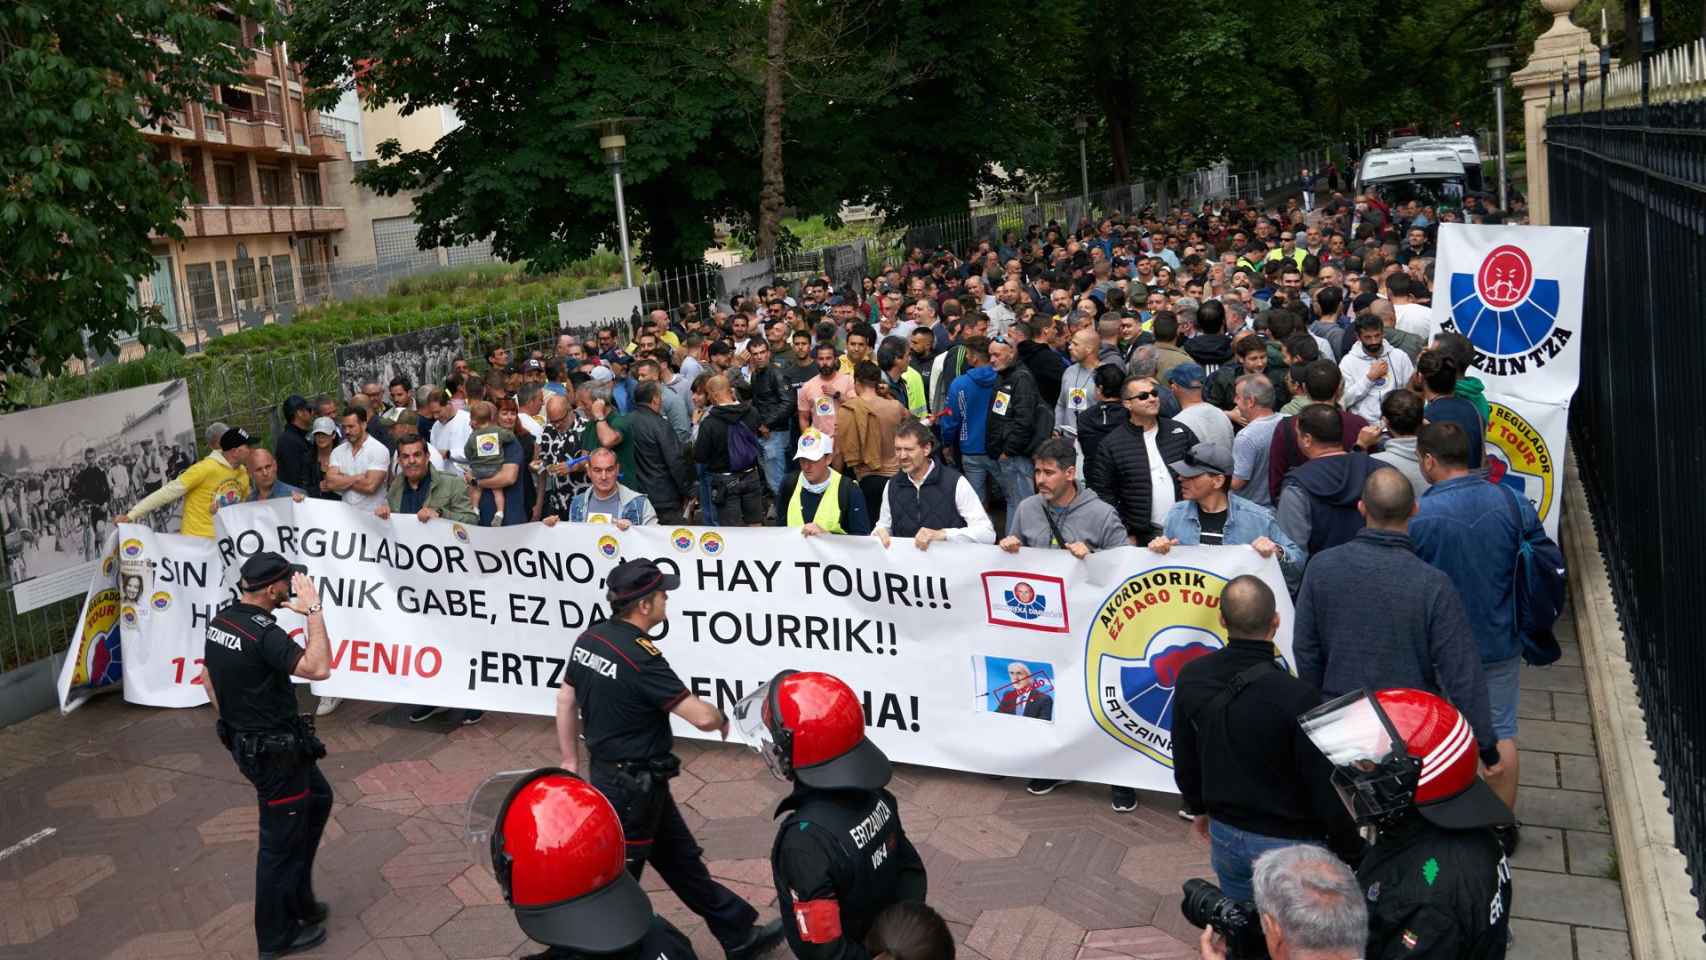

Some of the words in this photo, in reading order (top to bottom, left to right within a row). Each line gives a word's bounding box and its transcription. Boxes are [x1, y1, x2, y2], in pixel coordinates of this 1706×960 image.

[1440, 317, 1573, 376] EZAINTZA
[1496, 407, 1551, 474] REGULADOR
[1500, 425, 1537, 466] TOUR
[151, 557, 208, 591] ¡SIN
[474, 550, 606, 590] DIGNO,
[696, 558, 782, 593] HAY
[794, 561, 952, 610] TOUR!!!
[1100, 572, 1206, 628] AKORDIORIK
[397, 586, 497, 626] GABE,
[510, 593, 548, 626] EZ
[561, 600, 670, 640] DAO
[682, 609, 898, 657] TOURRIK!!
[1108, 618, 1125, 641] EZ
[1123, 589, 1171, 620] DAGO
[1179, 589, 1220, 609] TOU
[467, 649, 567, 691] ¡ERTZ
[849, 799, 891, 849] ERTZAINTZA
